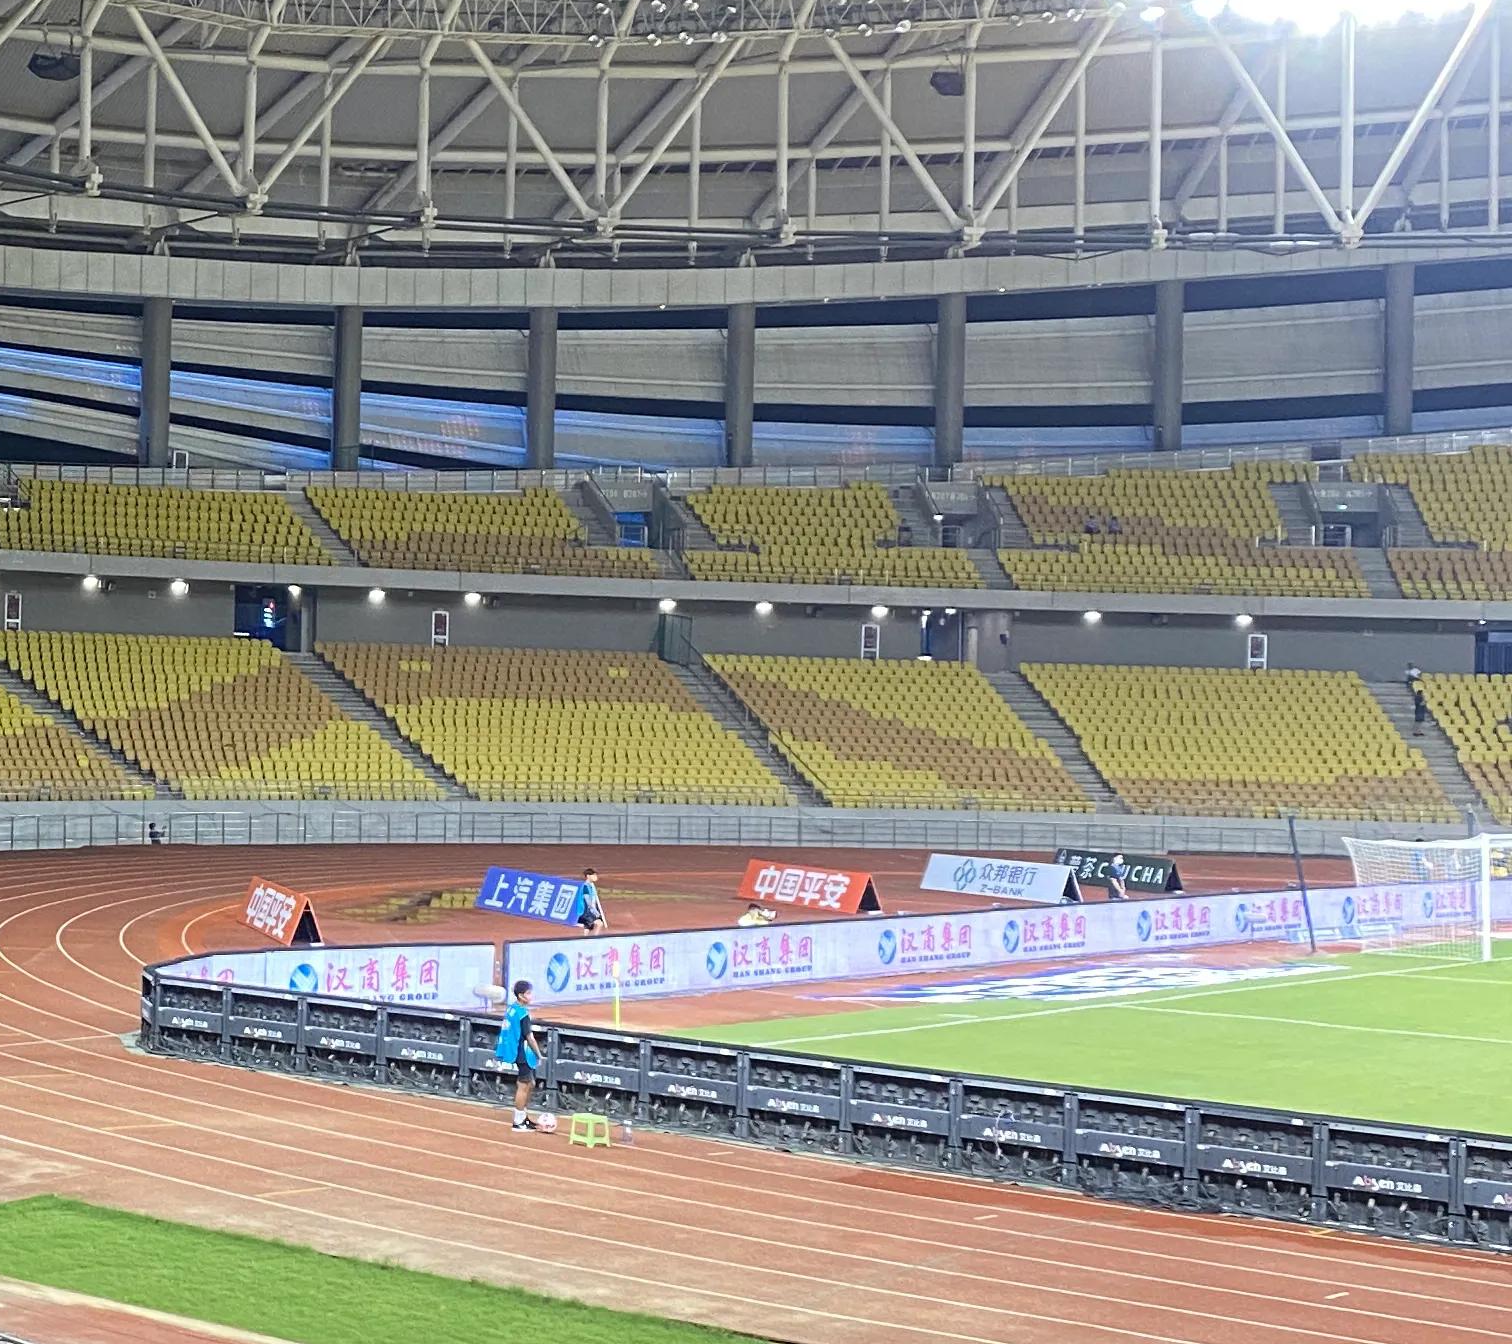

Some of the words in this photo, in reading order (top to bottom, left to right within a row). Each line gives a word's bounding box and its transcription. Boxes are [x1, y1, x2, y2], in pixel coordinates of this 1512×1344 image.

[753, 865, 851, 909] 中国平安
[979, 863, 1039, 886] 众邦银行
[979, 884, 1025, 897] Z-BANK
[245, 883, 297, 939] 中国平安
[484, 873, 580, 921] 上汽集团
[733, 933, 813, 967] 汉商集团
[901, 922, 972, 954] 汉商集团
[326, 954, 440, 992] 汉商集团
[575, 983, 595, 991] HAN
[634, 977, 665, 987] GROUP
[399, 992, 439, 1001] GROUP
